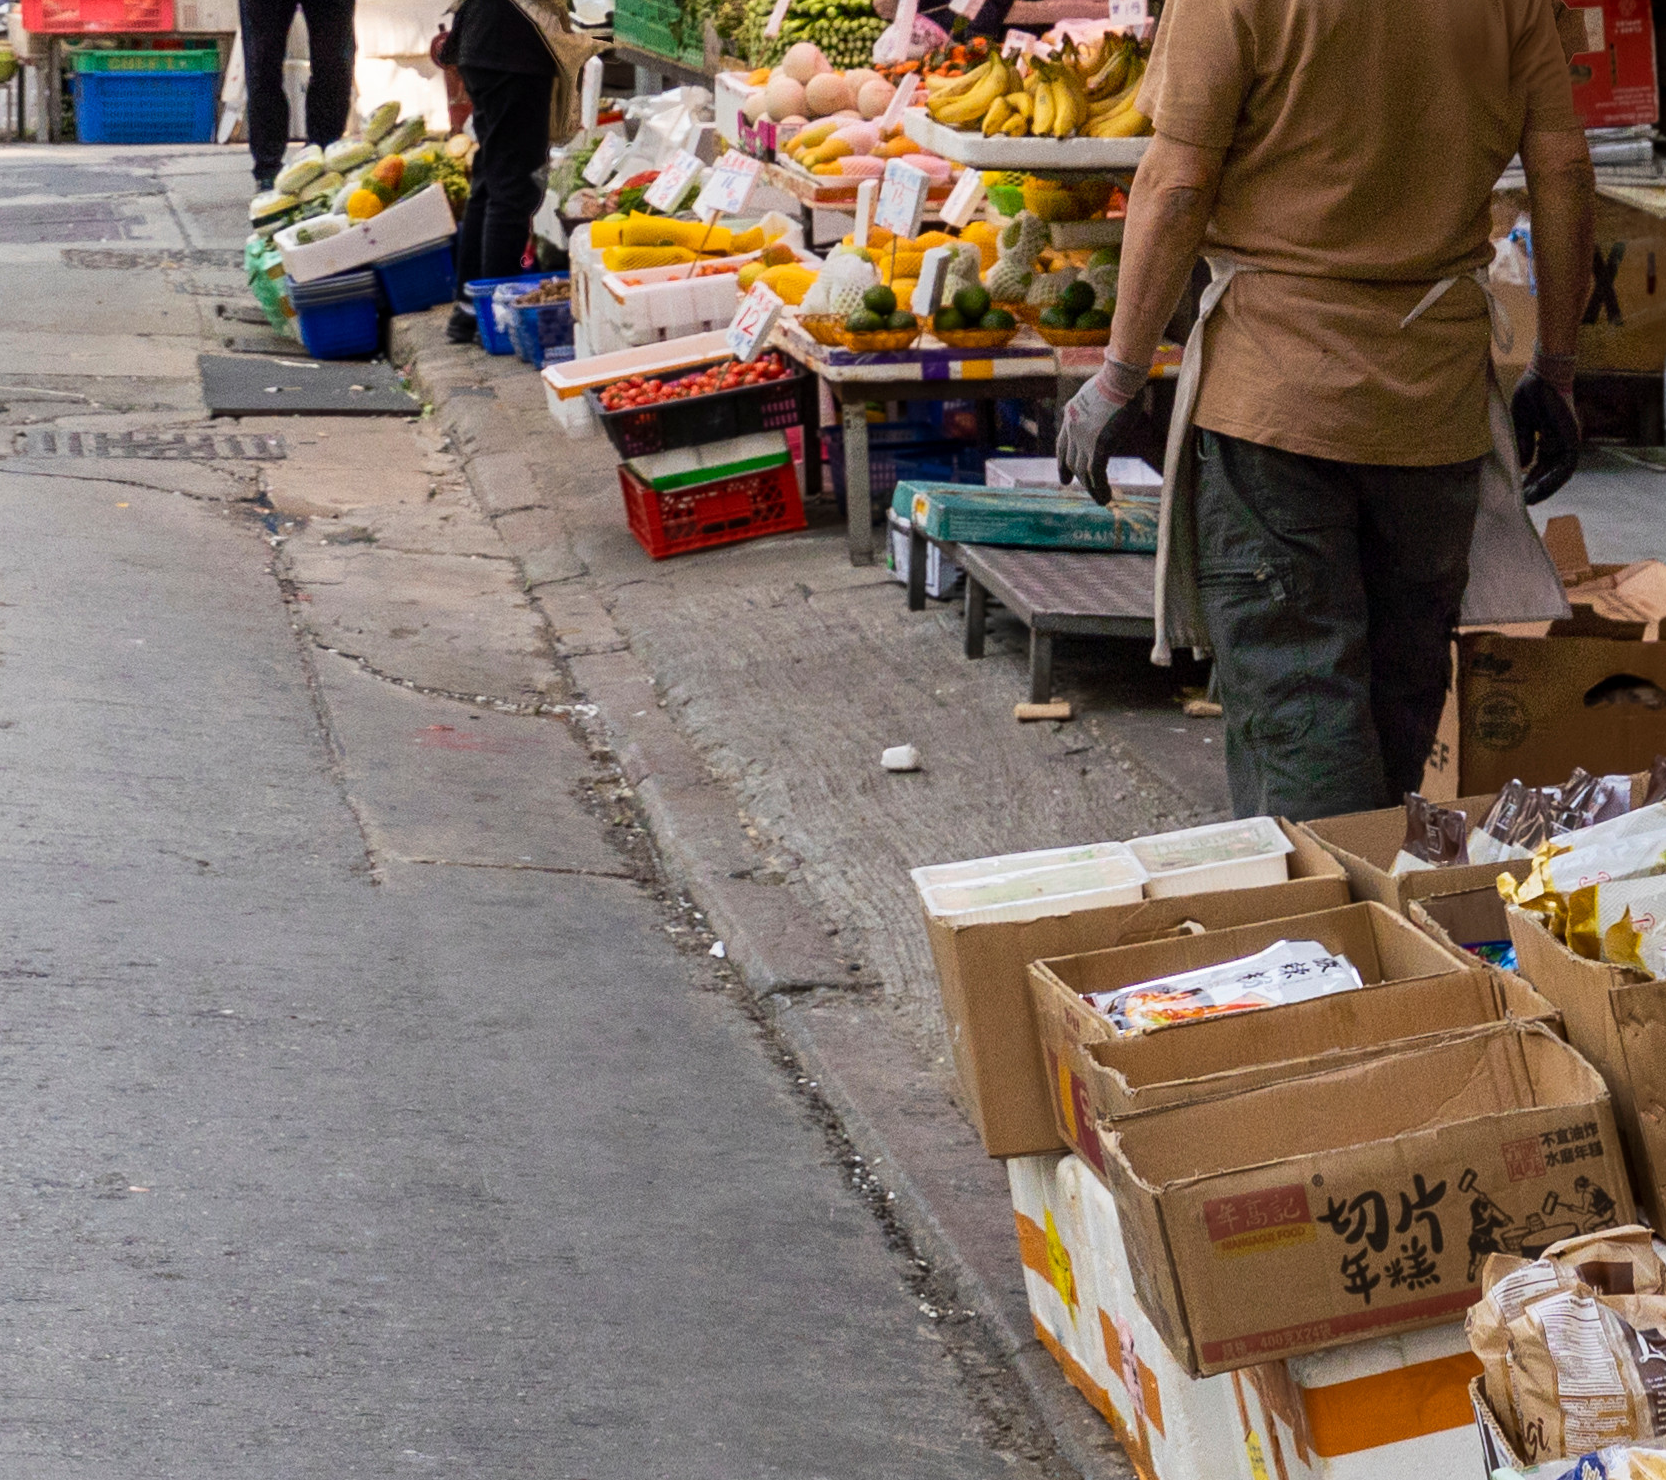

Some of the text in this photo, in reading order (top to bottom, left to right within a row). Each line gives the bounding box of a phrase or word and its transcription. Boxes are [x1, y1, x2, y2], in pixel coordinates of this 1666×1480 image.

[735, 306, 761, 337] 12
[1539, 1121, 1600, 1148] 不宜油炸
[1318, 1173, 1448, 1246] 切片
[1343, 1246, 1442, 1305] 年糕
